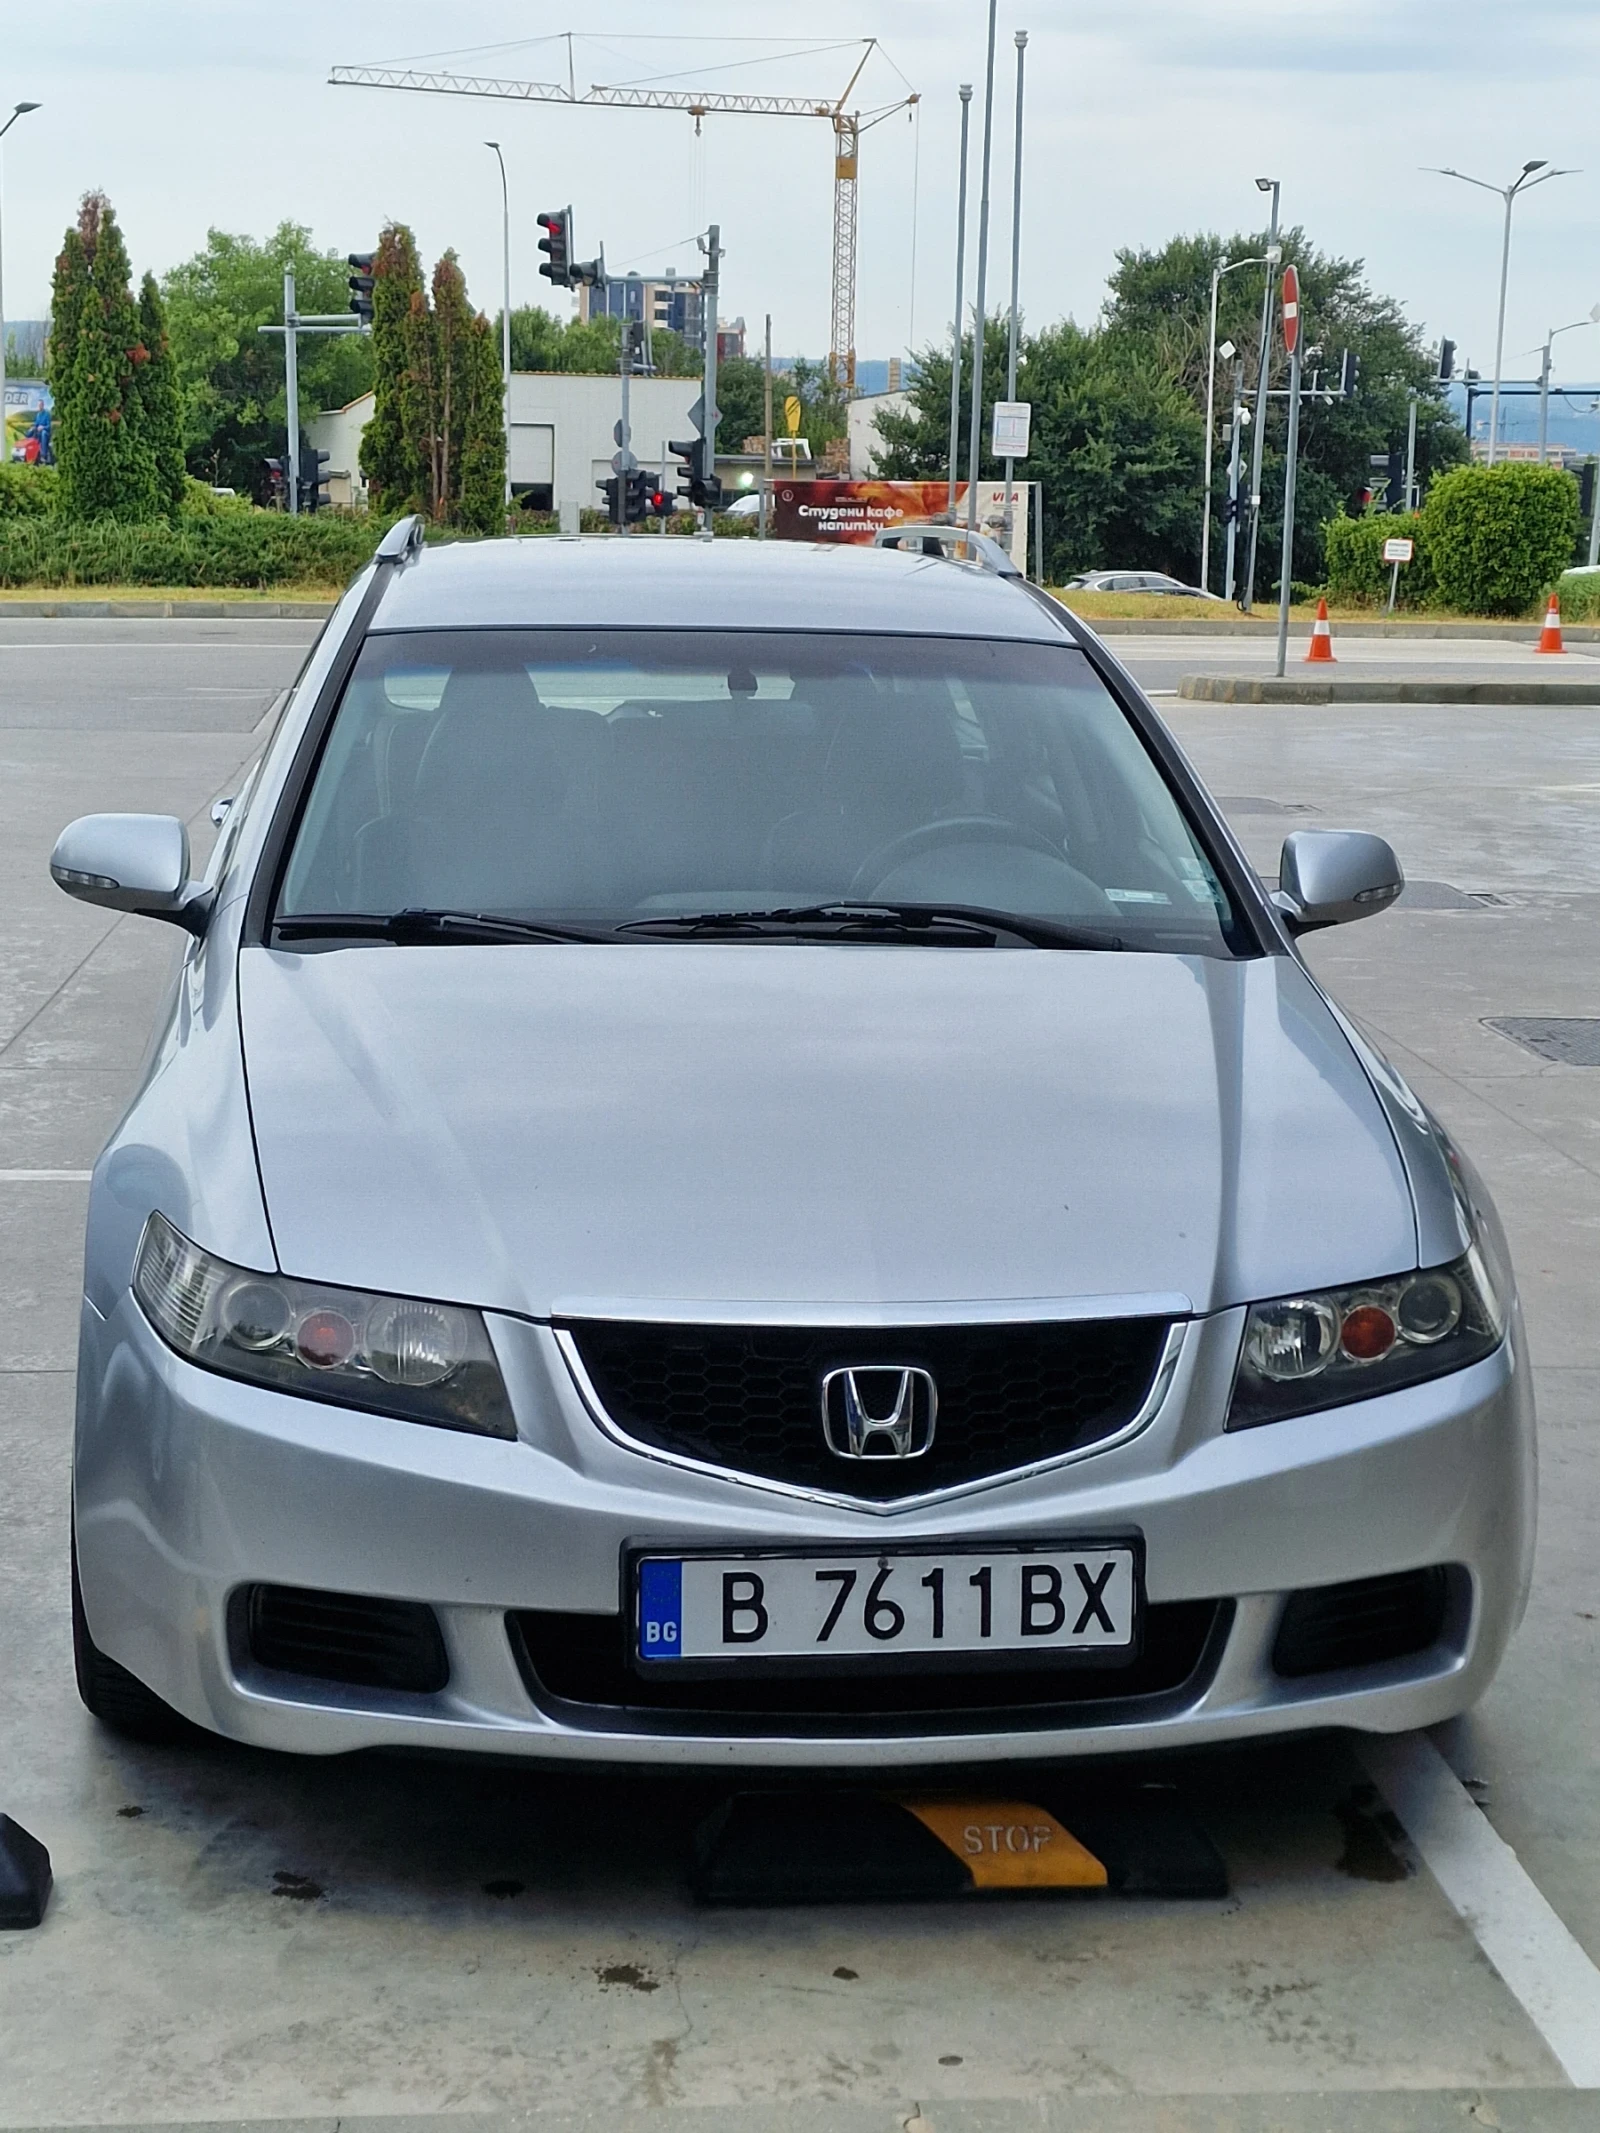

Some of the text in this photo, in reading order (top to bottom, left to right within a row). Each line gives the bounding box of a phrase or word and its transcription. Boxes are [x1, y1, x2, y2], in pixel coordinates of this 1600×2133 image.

[992, 492, 1019, 502] VIA
[798, 505, 904, 519] Студени кафе
[818, 520, 884, 531] напитки
[722, 1572, 768, 1643] B
[646, 1621, 677, 1643] BG
[963, 1825, 1052, 1854] STOP
